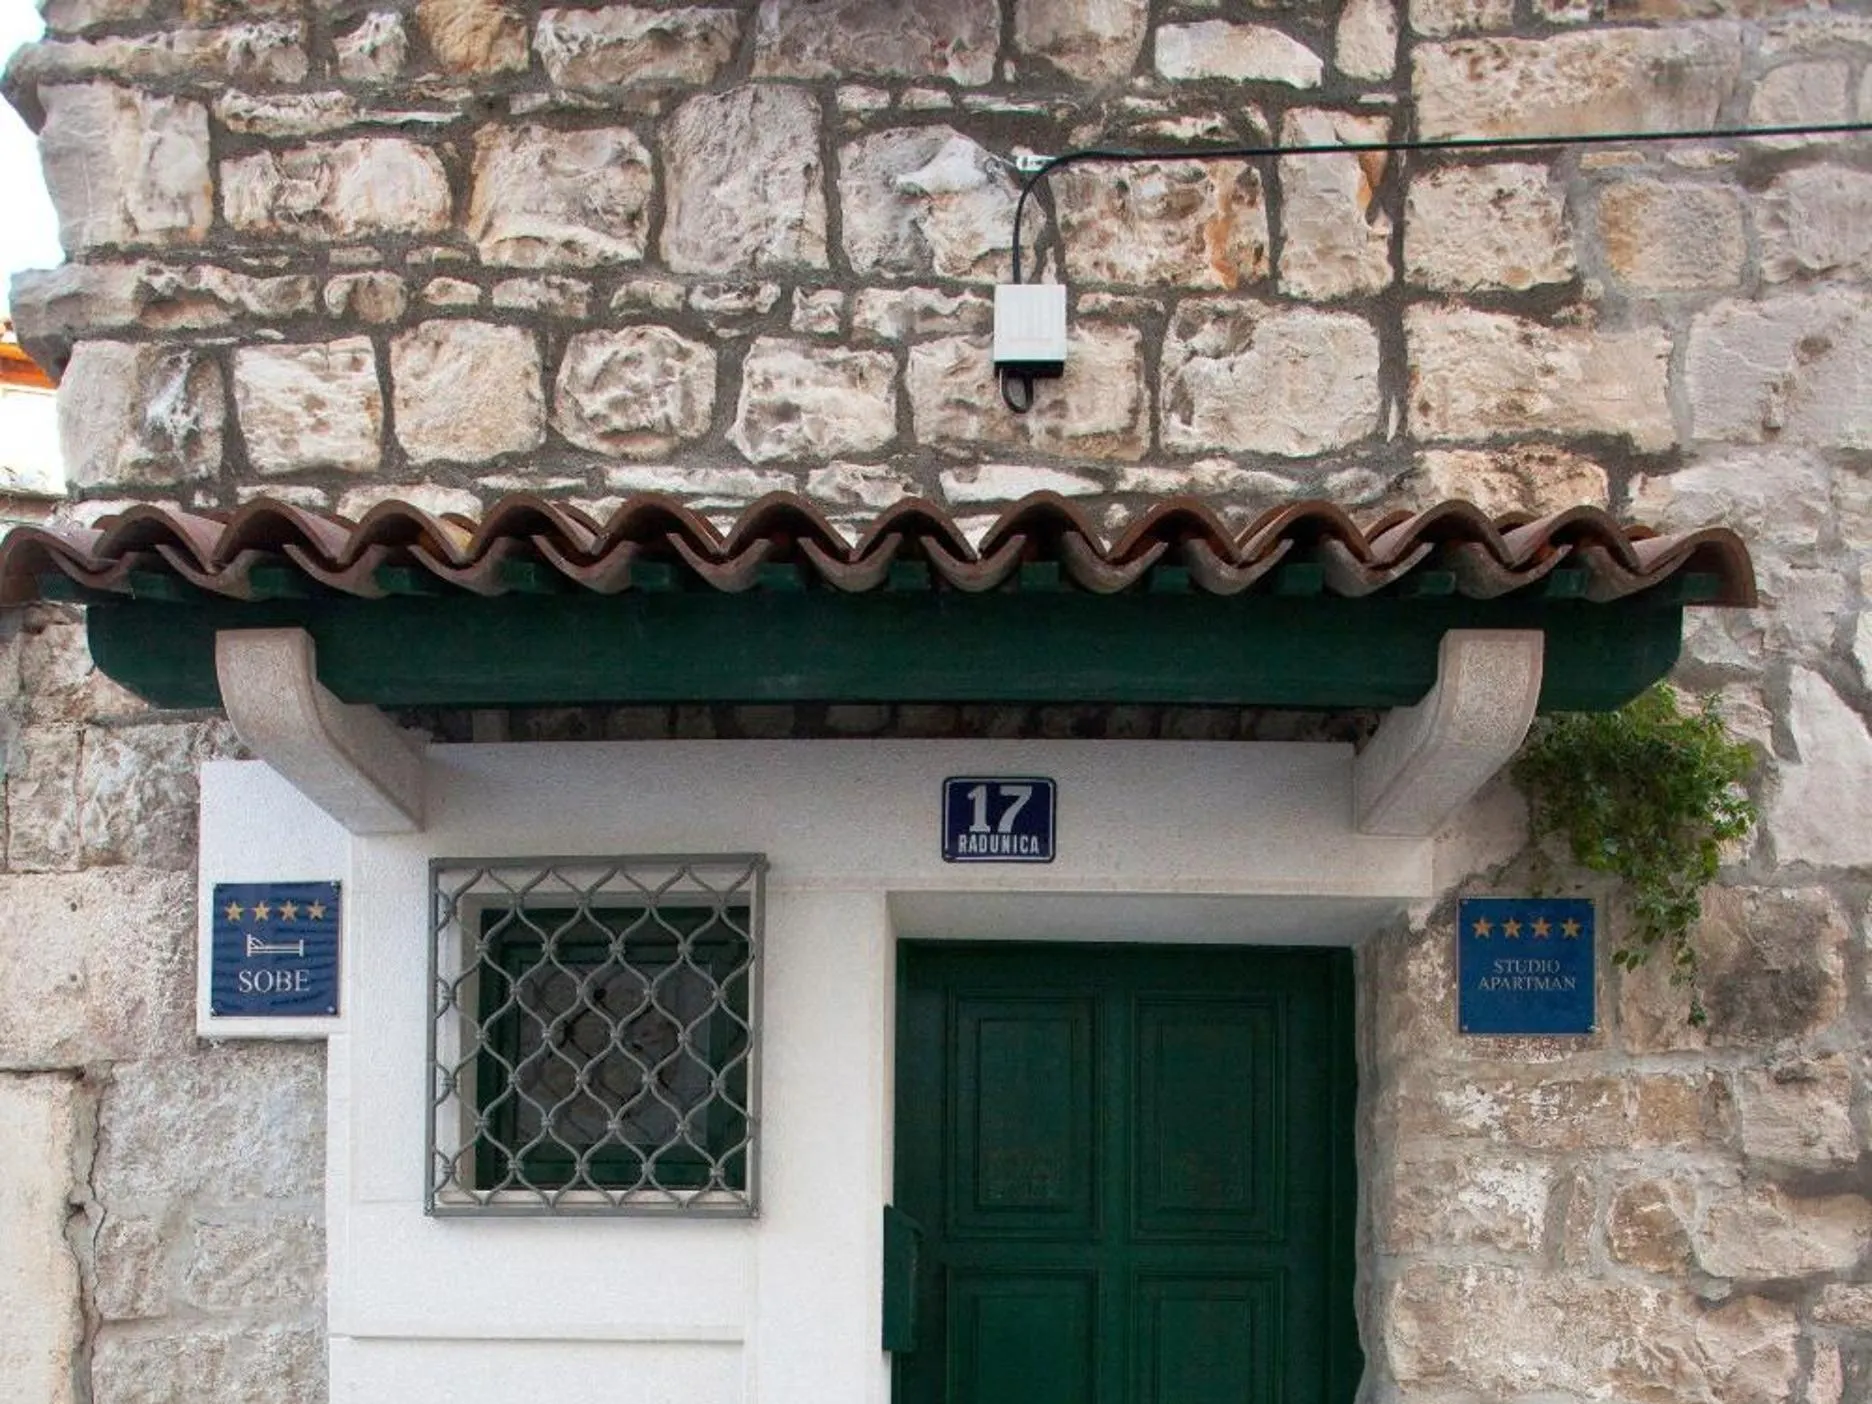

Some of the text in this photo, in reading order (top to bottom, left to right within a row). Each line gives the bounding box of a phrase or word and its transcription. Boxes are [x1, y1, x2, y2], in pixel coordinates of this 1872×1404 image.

[967, 785, 1032, 833] 17
[958, 834, 1039, 854] RADUNICA
[1493, 959, 1560, 974] STUDIO
[239, 969, 310, 993] SOBE
[1478, 976, 1576, 990] APARTMAN
